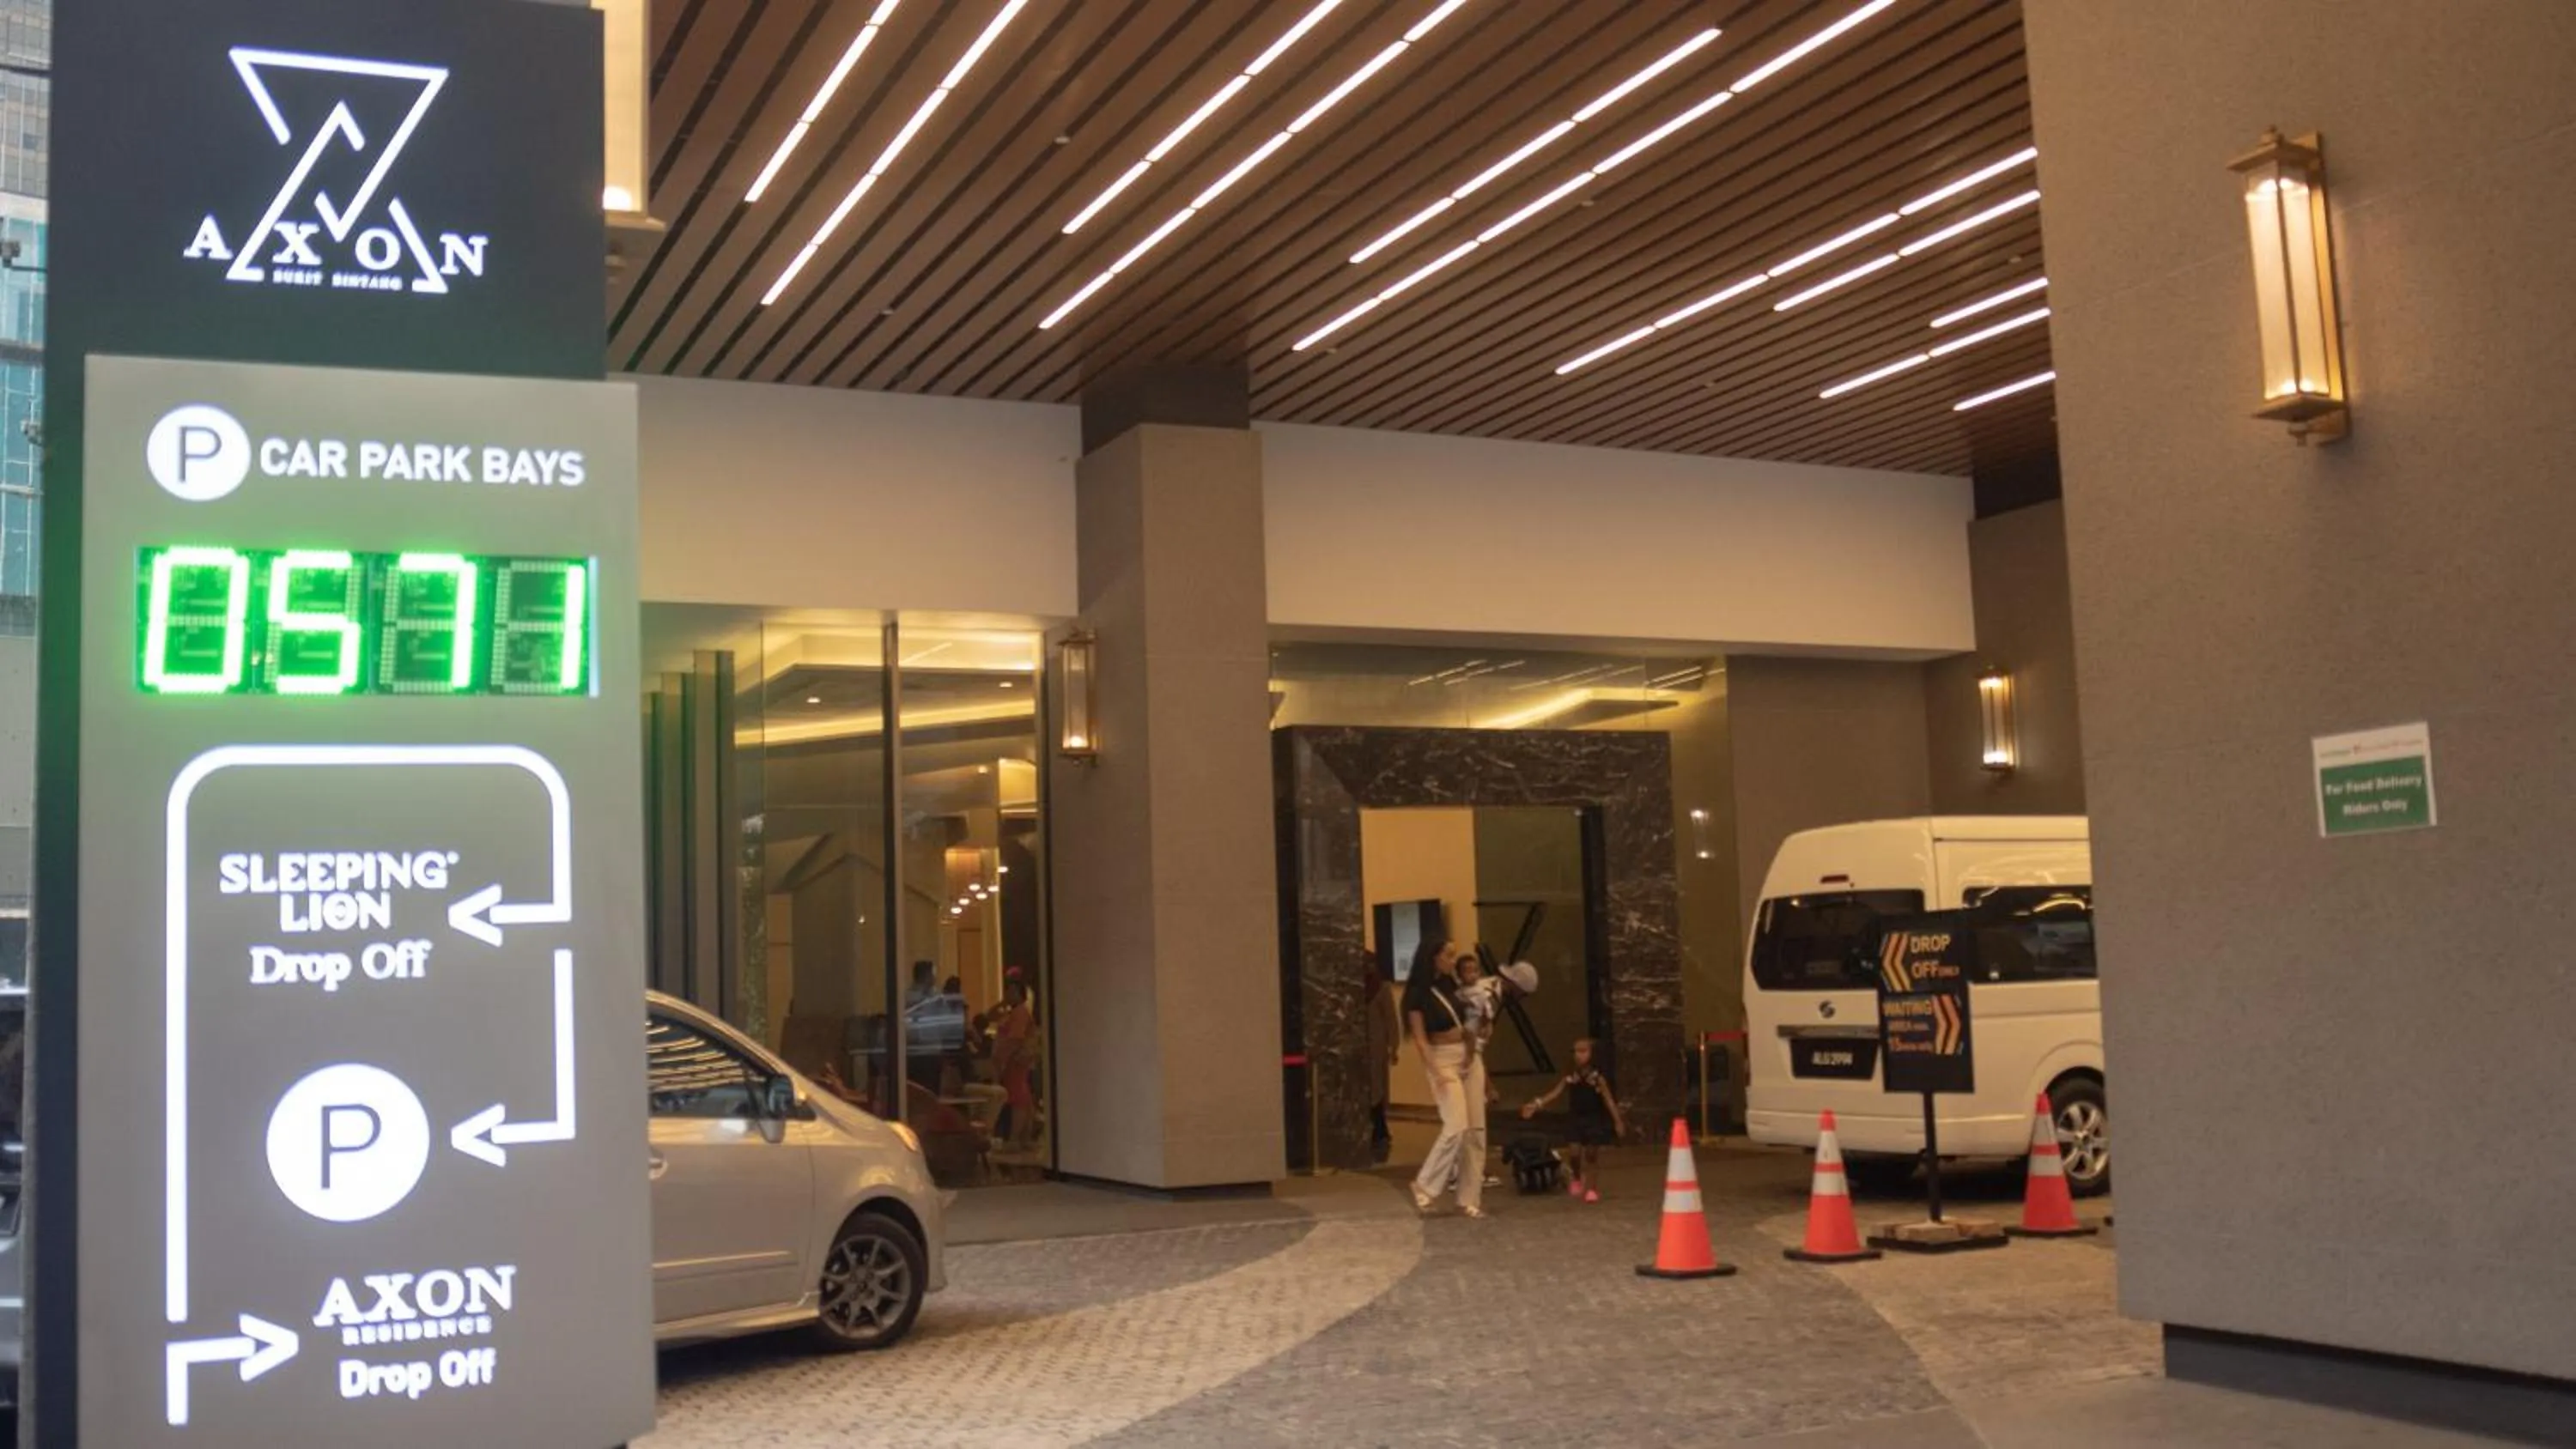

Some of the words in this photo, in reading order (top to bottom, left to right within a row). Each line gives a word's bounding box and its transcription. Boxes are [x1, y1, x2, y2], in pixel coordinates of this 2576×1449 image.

[183, 214, 489, 276] AXON
[260, 438, 348, 478] CAR
[360, 441, 472, 482] PARK
[482, 446, 586, 487] BAYS
[143, 545, 586, 694] 0571
[2346, 779, 2374, 794] Food
[2376, 775, 2422, 791] Delivery
[219, 851, 449, 894] SLEEPING
[280, 890, 391, 932] LION
[248, 945, 352, 991] Drop
[361, 939, 434, 980] Off
[1911, 934, 1951, 953] DROP
[1911, 961, 1939, 979] OFF
[1883, 999, 1932, 1017] WAITING
[312, 1264, 517, 1327] AXON
[342, 1315, 492, 1346] RESIDENCE
[339, 1358, 433, 1400] Drop
[439, 1347, 497, 1388] Off
